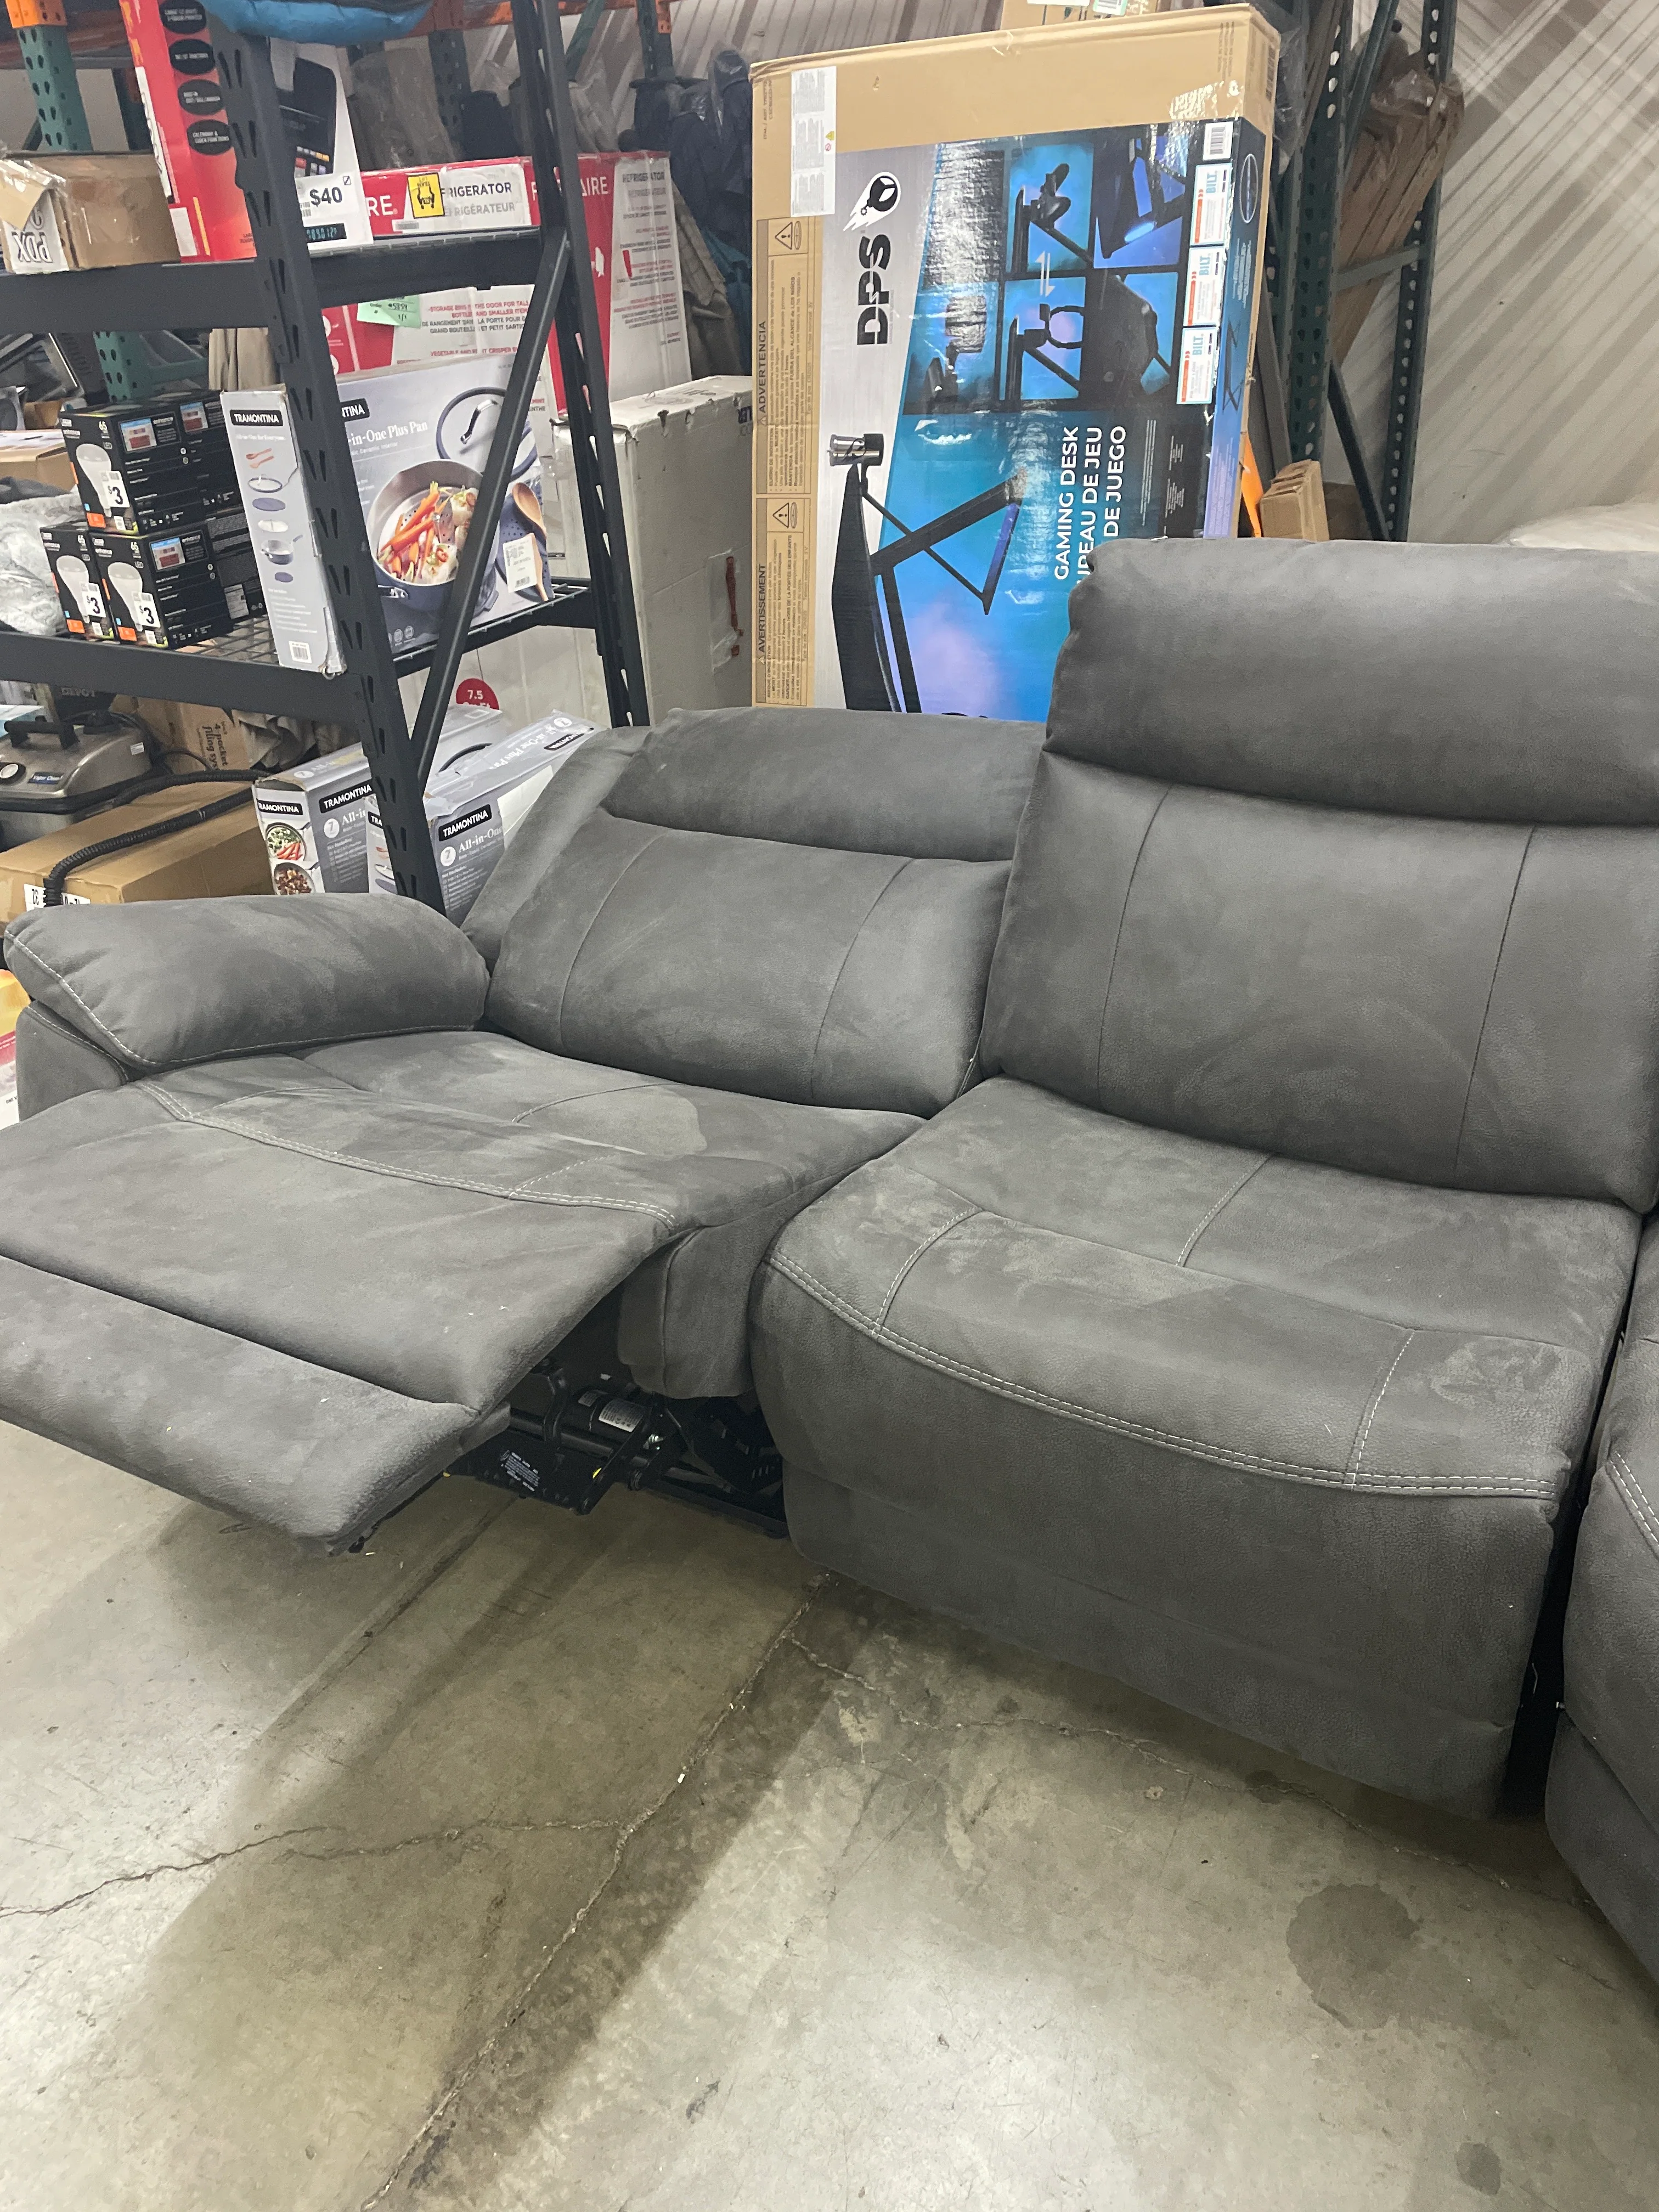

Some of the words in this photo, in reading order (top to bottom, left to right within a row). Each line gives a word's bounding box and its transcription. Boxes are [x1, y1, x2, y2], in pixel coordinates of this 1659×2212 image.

[1206, 174, 1218, 194] BILT
[309, 187, 343, 207] $40
[1199, 255, 1210, 276] BILT
[857, 234, 891, 345] DPS
[1192, 335, 1204, 356] BILT
[758, 321, 766, 413] ADVERTENCIA
[99, 421, 108, 431] 65
[234, 414, 279, 423] TRAMONTINA
[388, 424, 409, 438] Plus
[409, 421, 428, 434] Pan
[1060, 426, 1079, 485] DESK
[1085, 427, 1103, 469] JEU
[1106, 426, 1126, 503] JUEGO
[108, 486, 123, 505] $3
[1082, 474, 1100, 504] DE
[1104, 512, 1120, 537] DE
[1054, 492, 1074, 580] GAMING
[86, 596, 100, 614] $3
[139, 606, 155, 624] $3
[467, 690, 483, 699] 7.5
[324, 784, 373, 809] TRAMONTINA
[371, 815, 383, 826] TRA
[443, 810, 488, 837] TRAMONTINA
